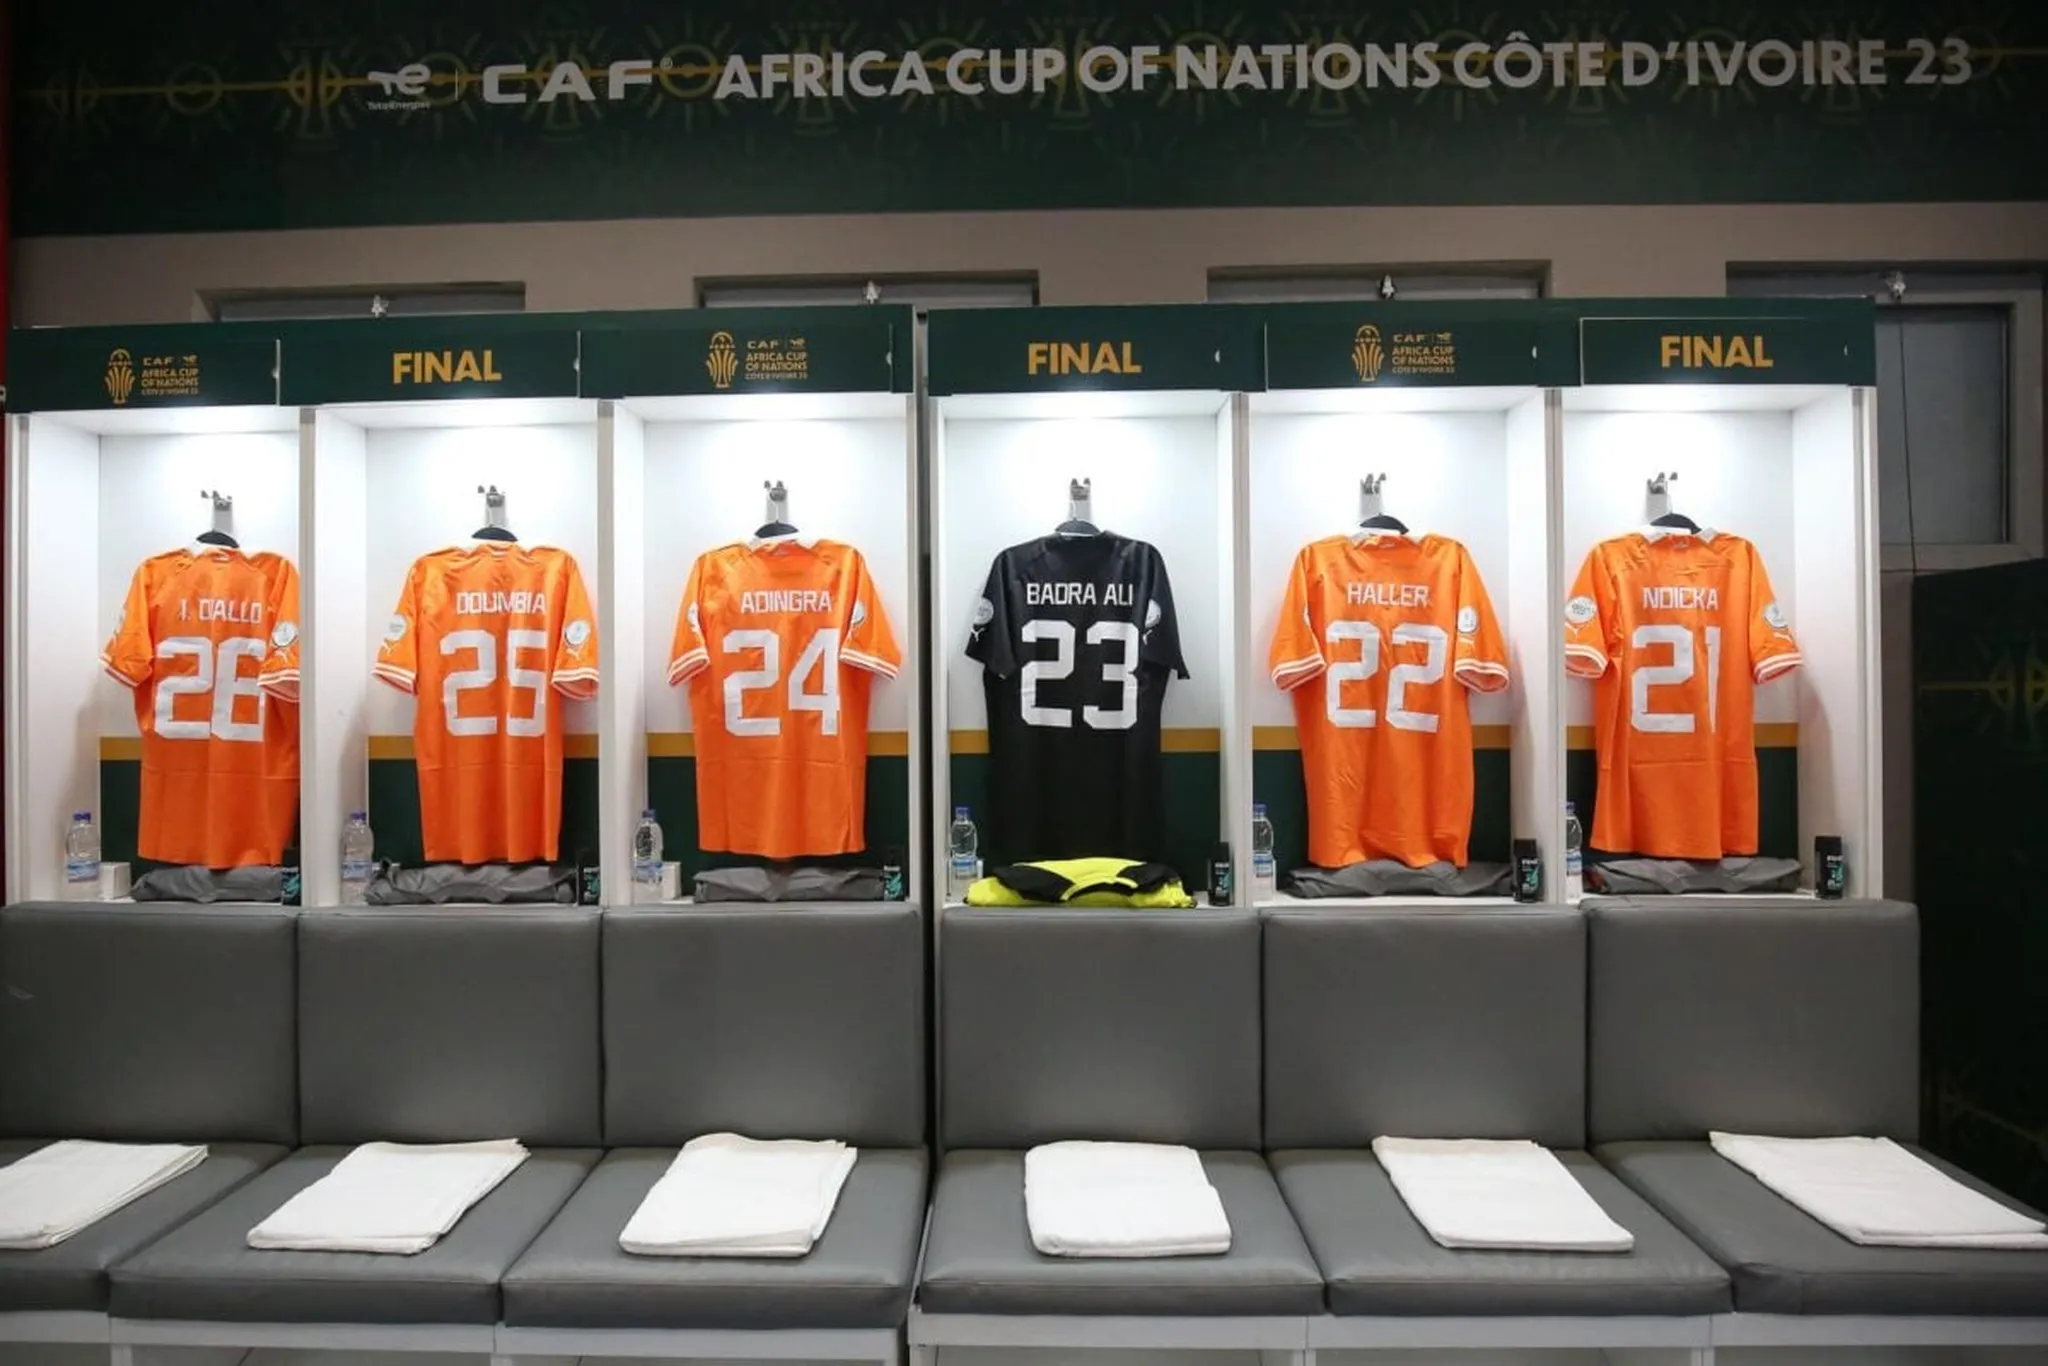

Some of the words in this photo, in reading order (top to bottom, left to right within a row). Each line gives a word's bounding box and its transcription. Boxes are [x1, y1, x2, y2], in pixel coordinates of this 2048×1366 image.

[713, 51, 935, 99] AFRICA
[945, 48, 1066, 95] CUP
[1078, 45, 1160, 93] OF
[1175, 42, 1441, 90] NATIONS
[1453, 31, 1606, 88] CÔTE
[1622, 39, 1887, 87] D'IVOIRE
[1904, 38, 1971, 85] 23
[393, 349, 503, 384] FINAL
[1028, 342, 1142, 375] FINAL
[1660, 335, 1774, 368] FINAL
[455, 590, 546, 615] DOUMBIA
[740, 589, 832, 613] ADINGRA
[1026, 582, 1097, 605] BADRA
[1103, 583, 1133, 606] ALI
[1347, 582, 1429, 608] HALLER
[1642, 586, 1719, 610] NDICKA
[154, 636, 267, 742] 26
[440, 629, 549, 737] 25
[722, 627, 840, 736] 24
[1021, 619, 1139, 729] 23
[1325, 620, 1448, 733] 22
[1631, 624, 1721, 733] 21
